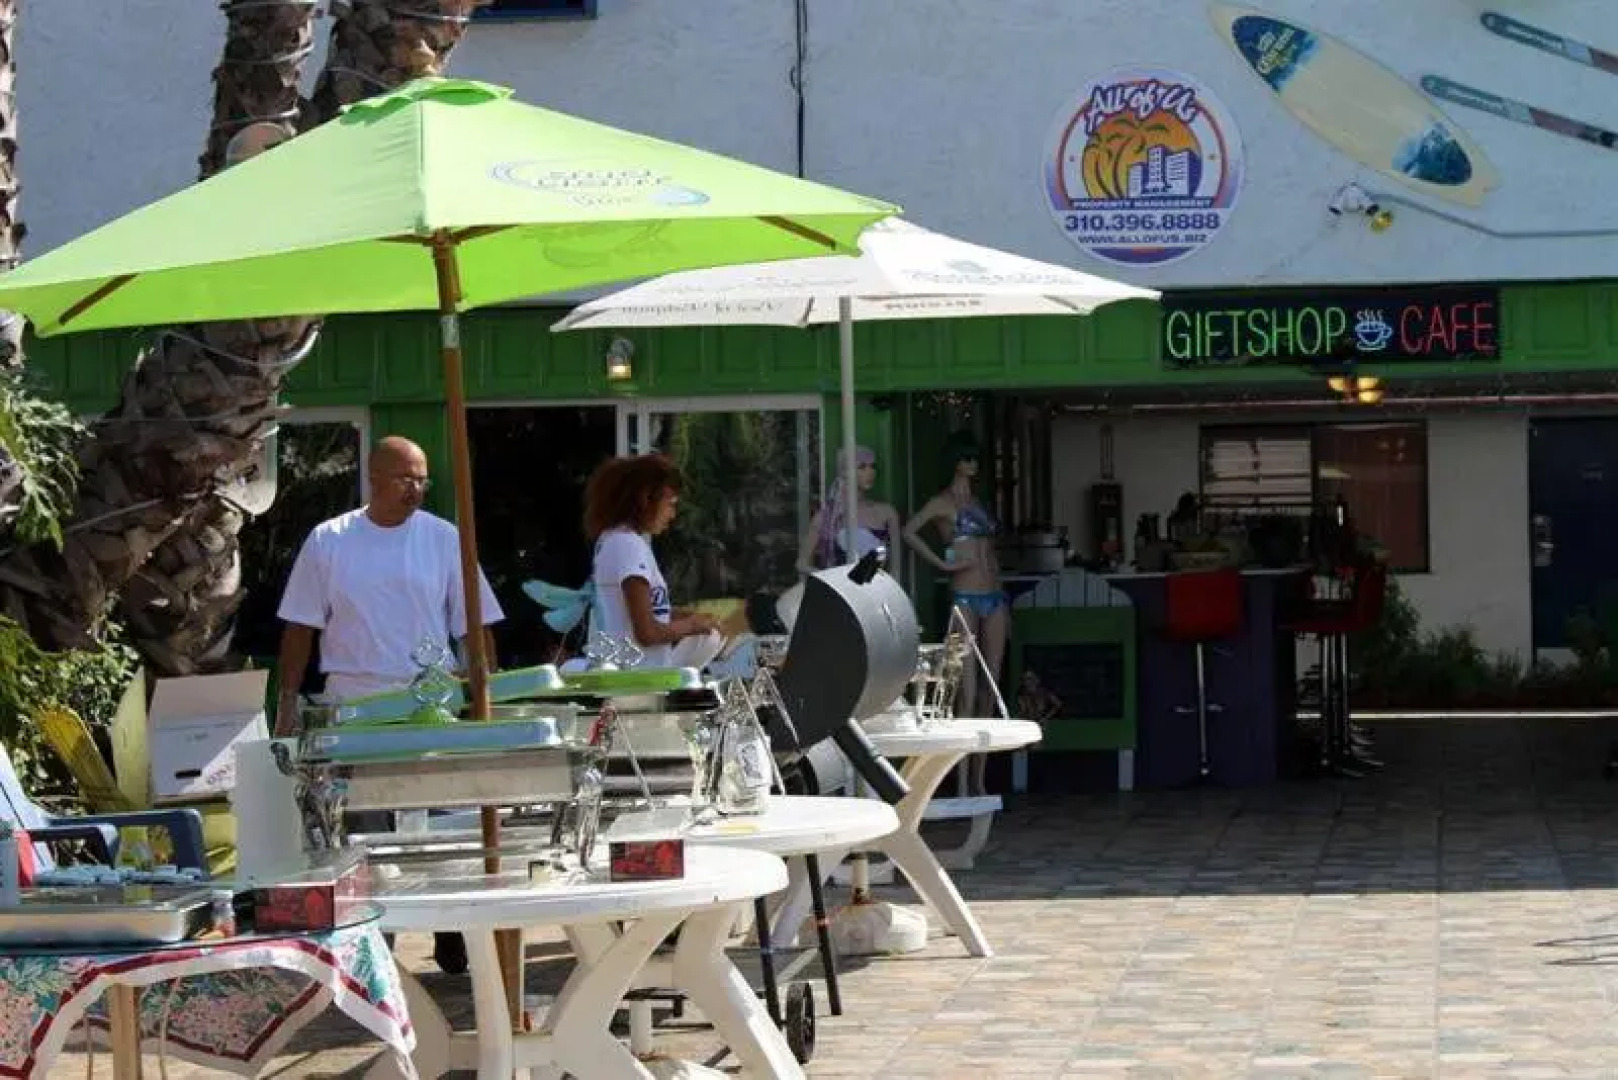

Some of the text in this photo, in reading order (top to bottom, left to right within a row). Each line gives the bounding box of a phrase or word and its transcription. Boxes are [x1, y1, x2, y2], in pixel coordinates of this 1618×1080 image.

[1065, 213, 1220, 231] 310.396.8888
[1166, 302, 1496, 359] GIFTSHOP CAFE
